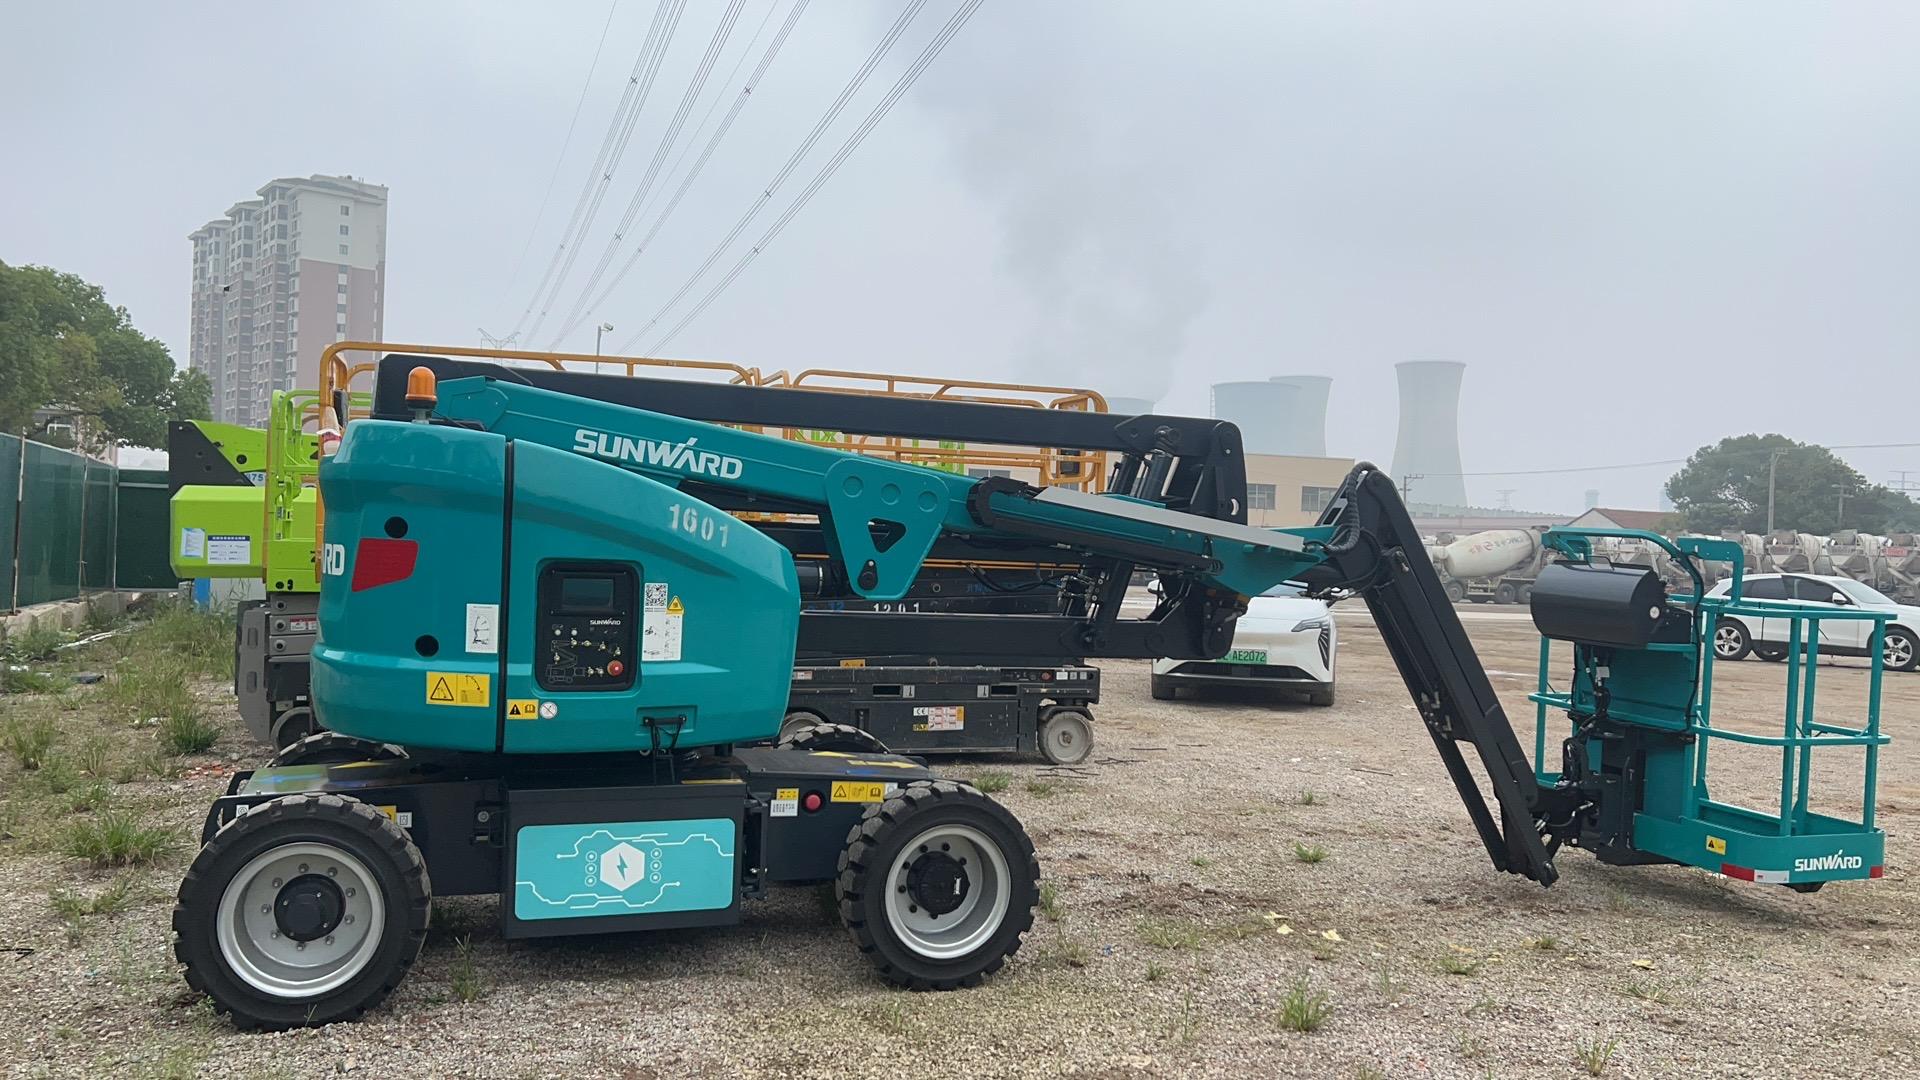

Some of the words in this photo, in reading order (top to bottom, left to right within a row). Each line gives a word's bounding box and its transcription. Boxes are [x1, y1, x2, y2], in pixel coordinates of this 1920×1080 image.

[573, 429, 743, 479] SUNWARD
[669, 504, 728, 547] 1601
[1232, 650, 1266, 662] AE2072
[1794, 850, 1862, 872] SUNWARD
